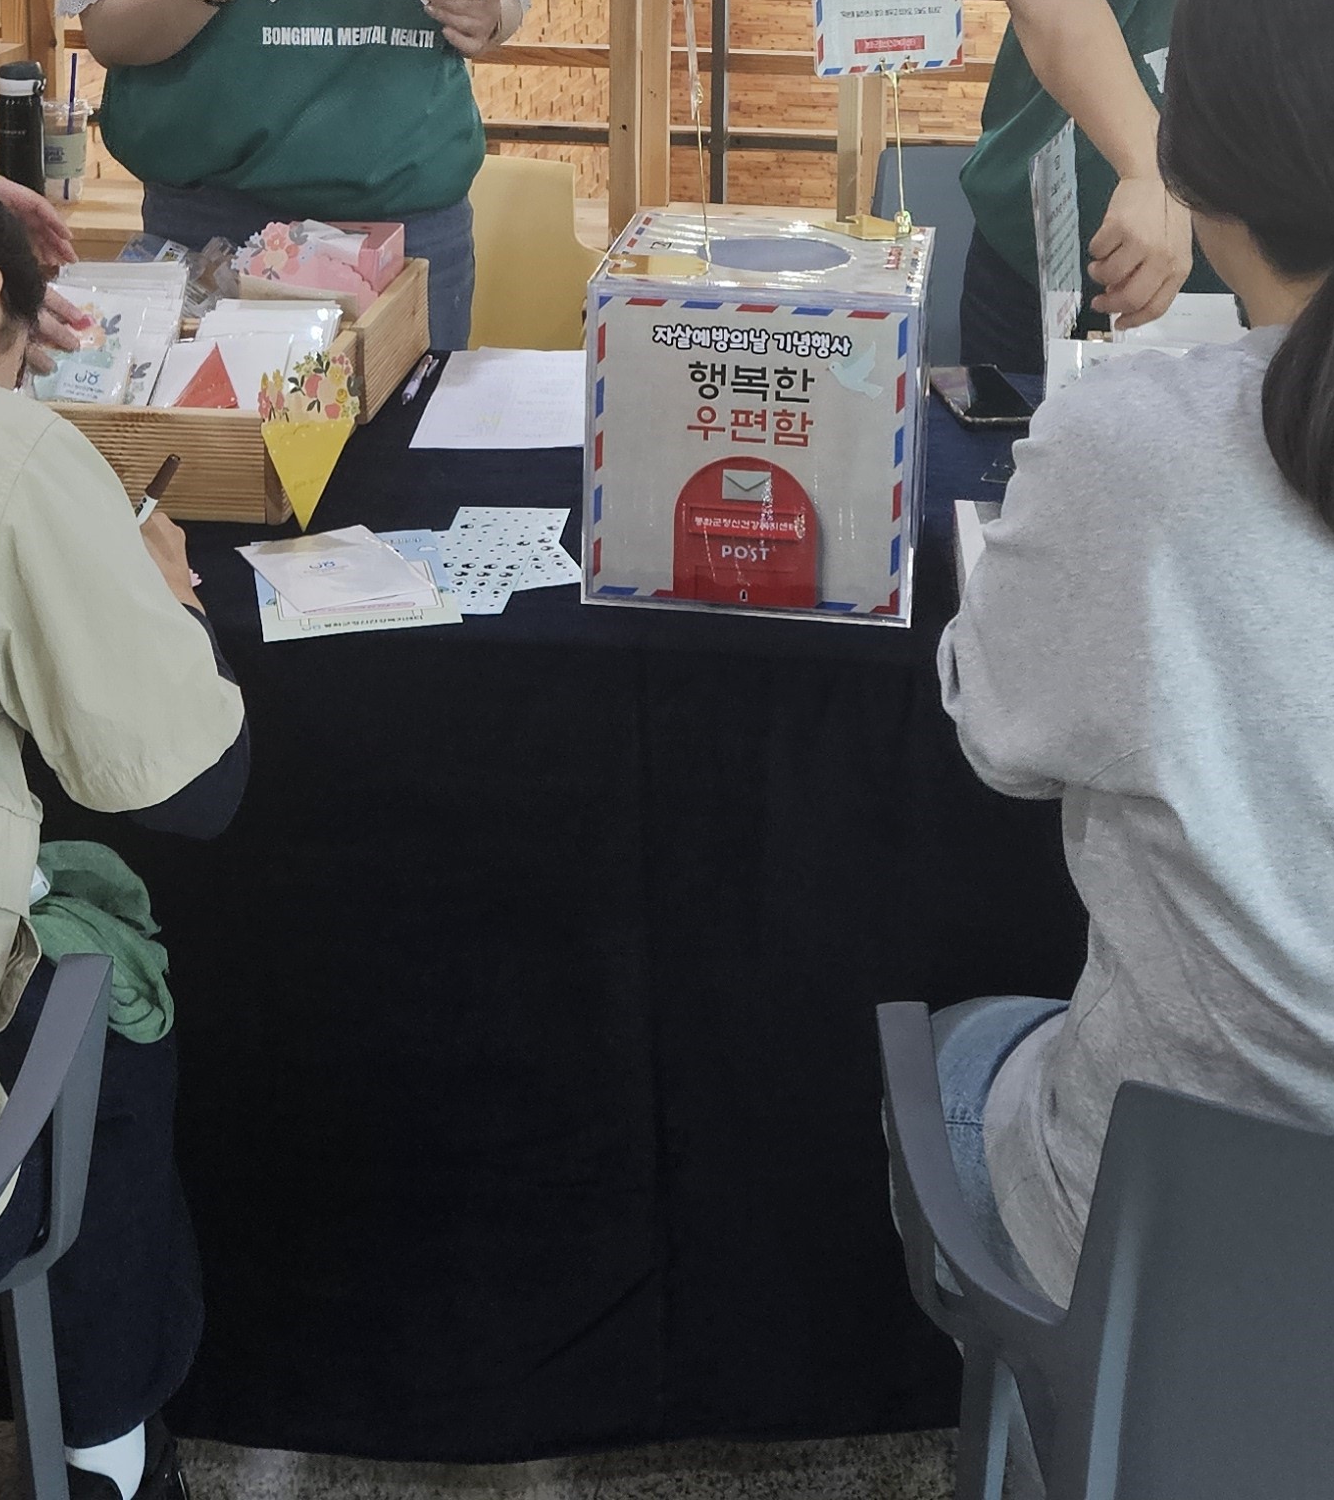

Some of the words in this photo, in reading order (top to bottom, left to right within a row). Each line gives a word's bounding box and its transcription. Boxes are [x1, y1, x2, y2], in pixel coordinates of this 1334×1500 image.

[262, 26, 333, 46] BONGHWA
[337, 25, 387, 46] MENTAL
[390, 27, 435, 48] HEALTH
[652, 324, 770, 354] 자살예방의날
[771, 332, 852, 358] 기념행사
[687, 361, 815, 403] 행복한
[687, 405, 814, 447] 우편함
[721, 545, 769, 562] POST
